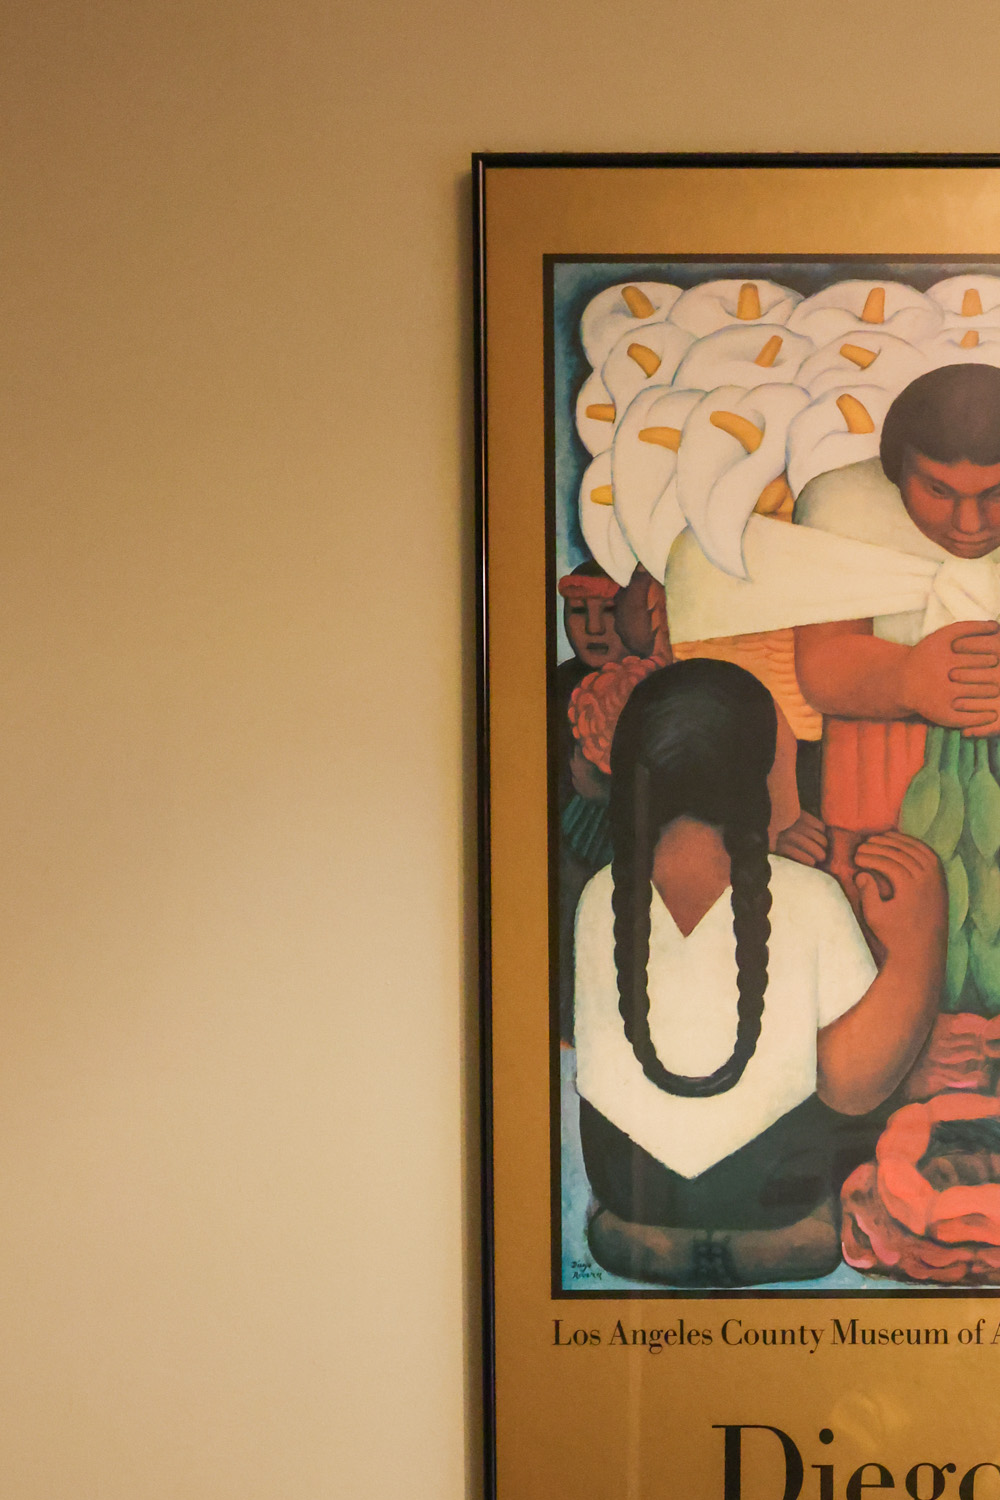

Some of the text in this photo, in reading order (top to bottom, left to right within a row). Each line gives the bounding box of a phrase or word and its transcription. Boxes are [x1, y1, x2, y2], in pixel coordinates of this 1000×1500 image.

[552, 1318, 603, 1346] Los
[608, 1318, 714, 1355] Angeles
[720, 1318, 823, 1354] County
[831, 1318, 949, 1345] Museum
[957, 1318, 987, 1346] of
